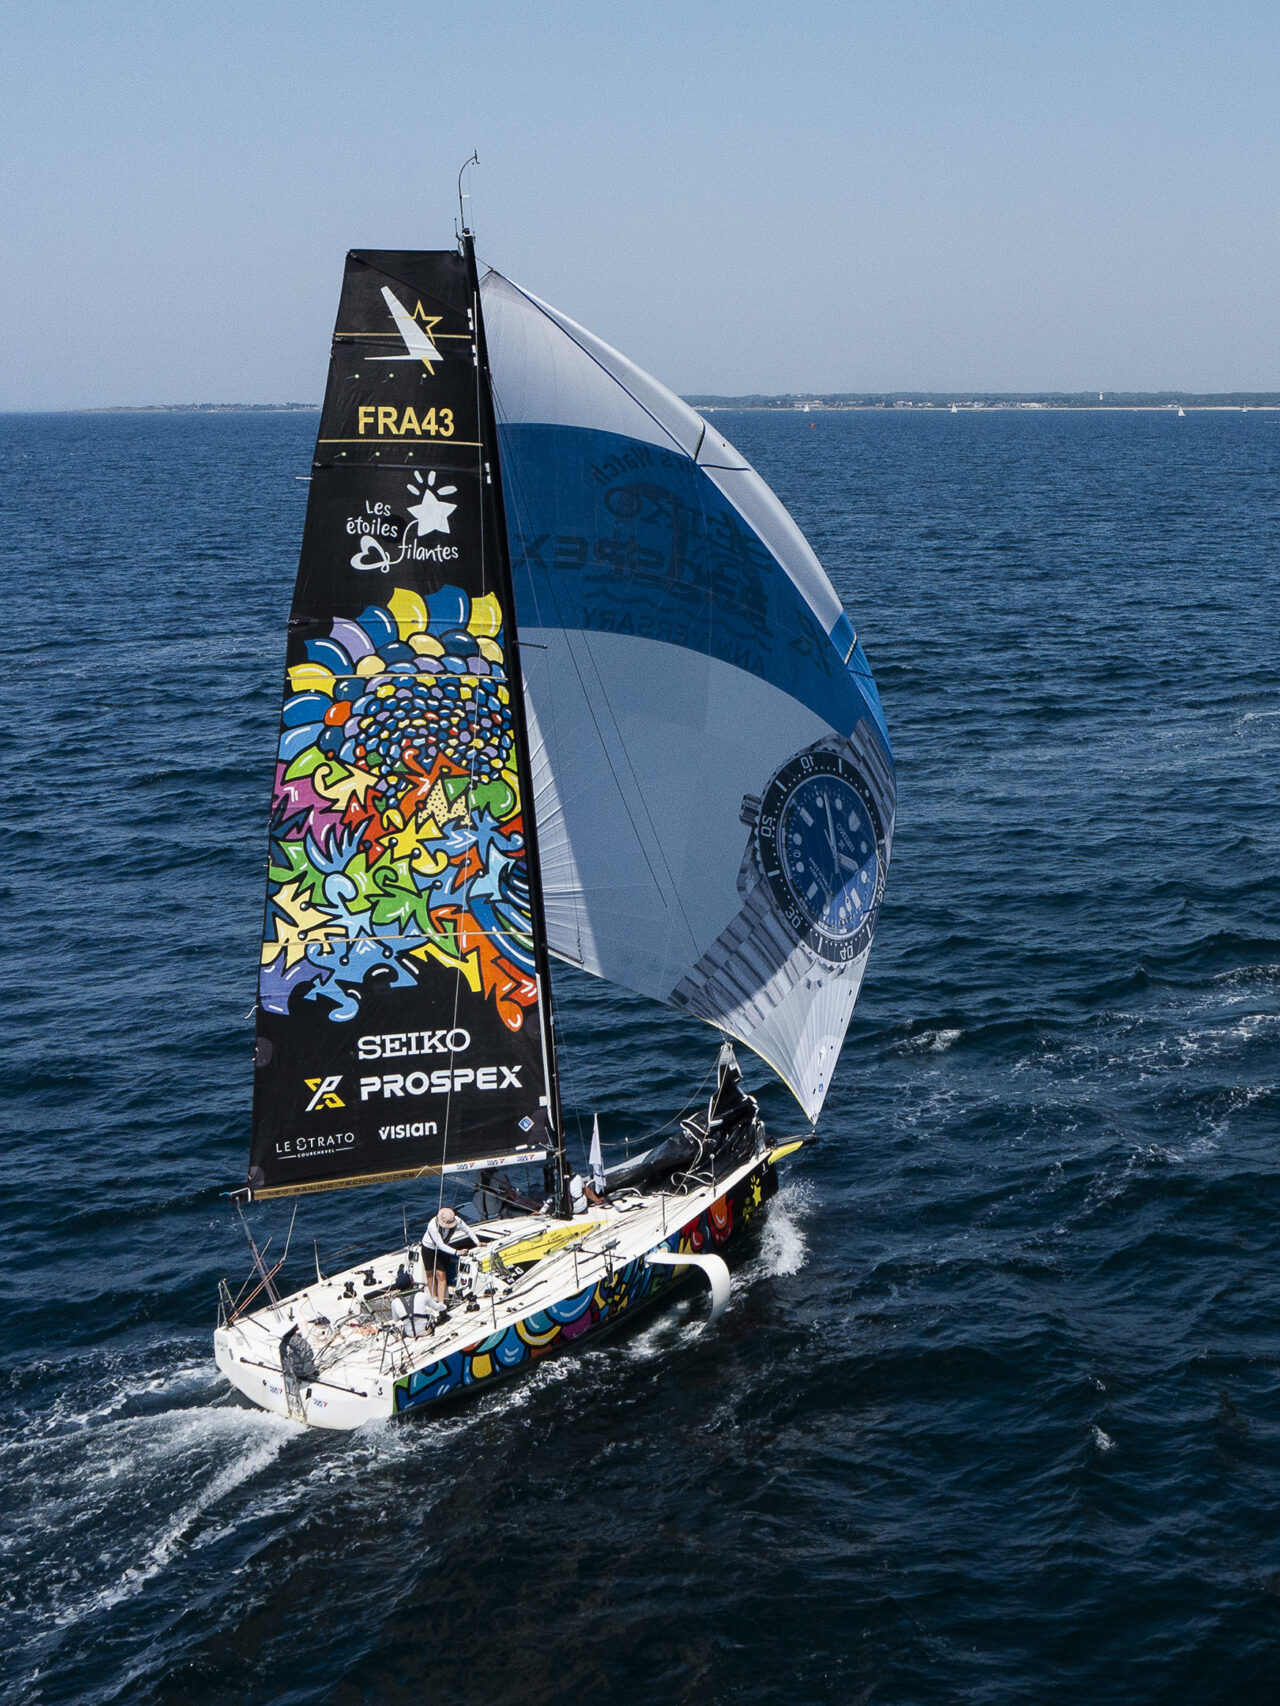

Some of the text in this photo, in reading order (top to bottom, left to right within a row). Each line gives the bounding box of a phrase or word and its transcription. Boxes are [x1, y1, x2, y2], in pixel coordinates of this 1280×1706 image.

[358, 405, 455, 438] FRA43
[366, 500, 391, 517] Les
[346, 517, 398, 538] étoiles
[398, 530, 459, 563] filantes
[357, 1028, 471, 1060] SEIKO
[360, 1065, 523, 1101] PROSPEX
[276, 1132, 355, 1153] LE STRATO
